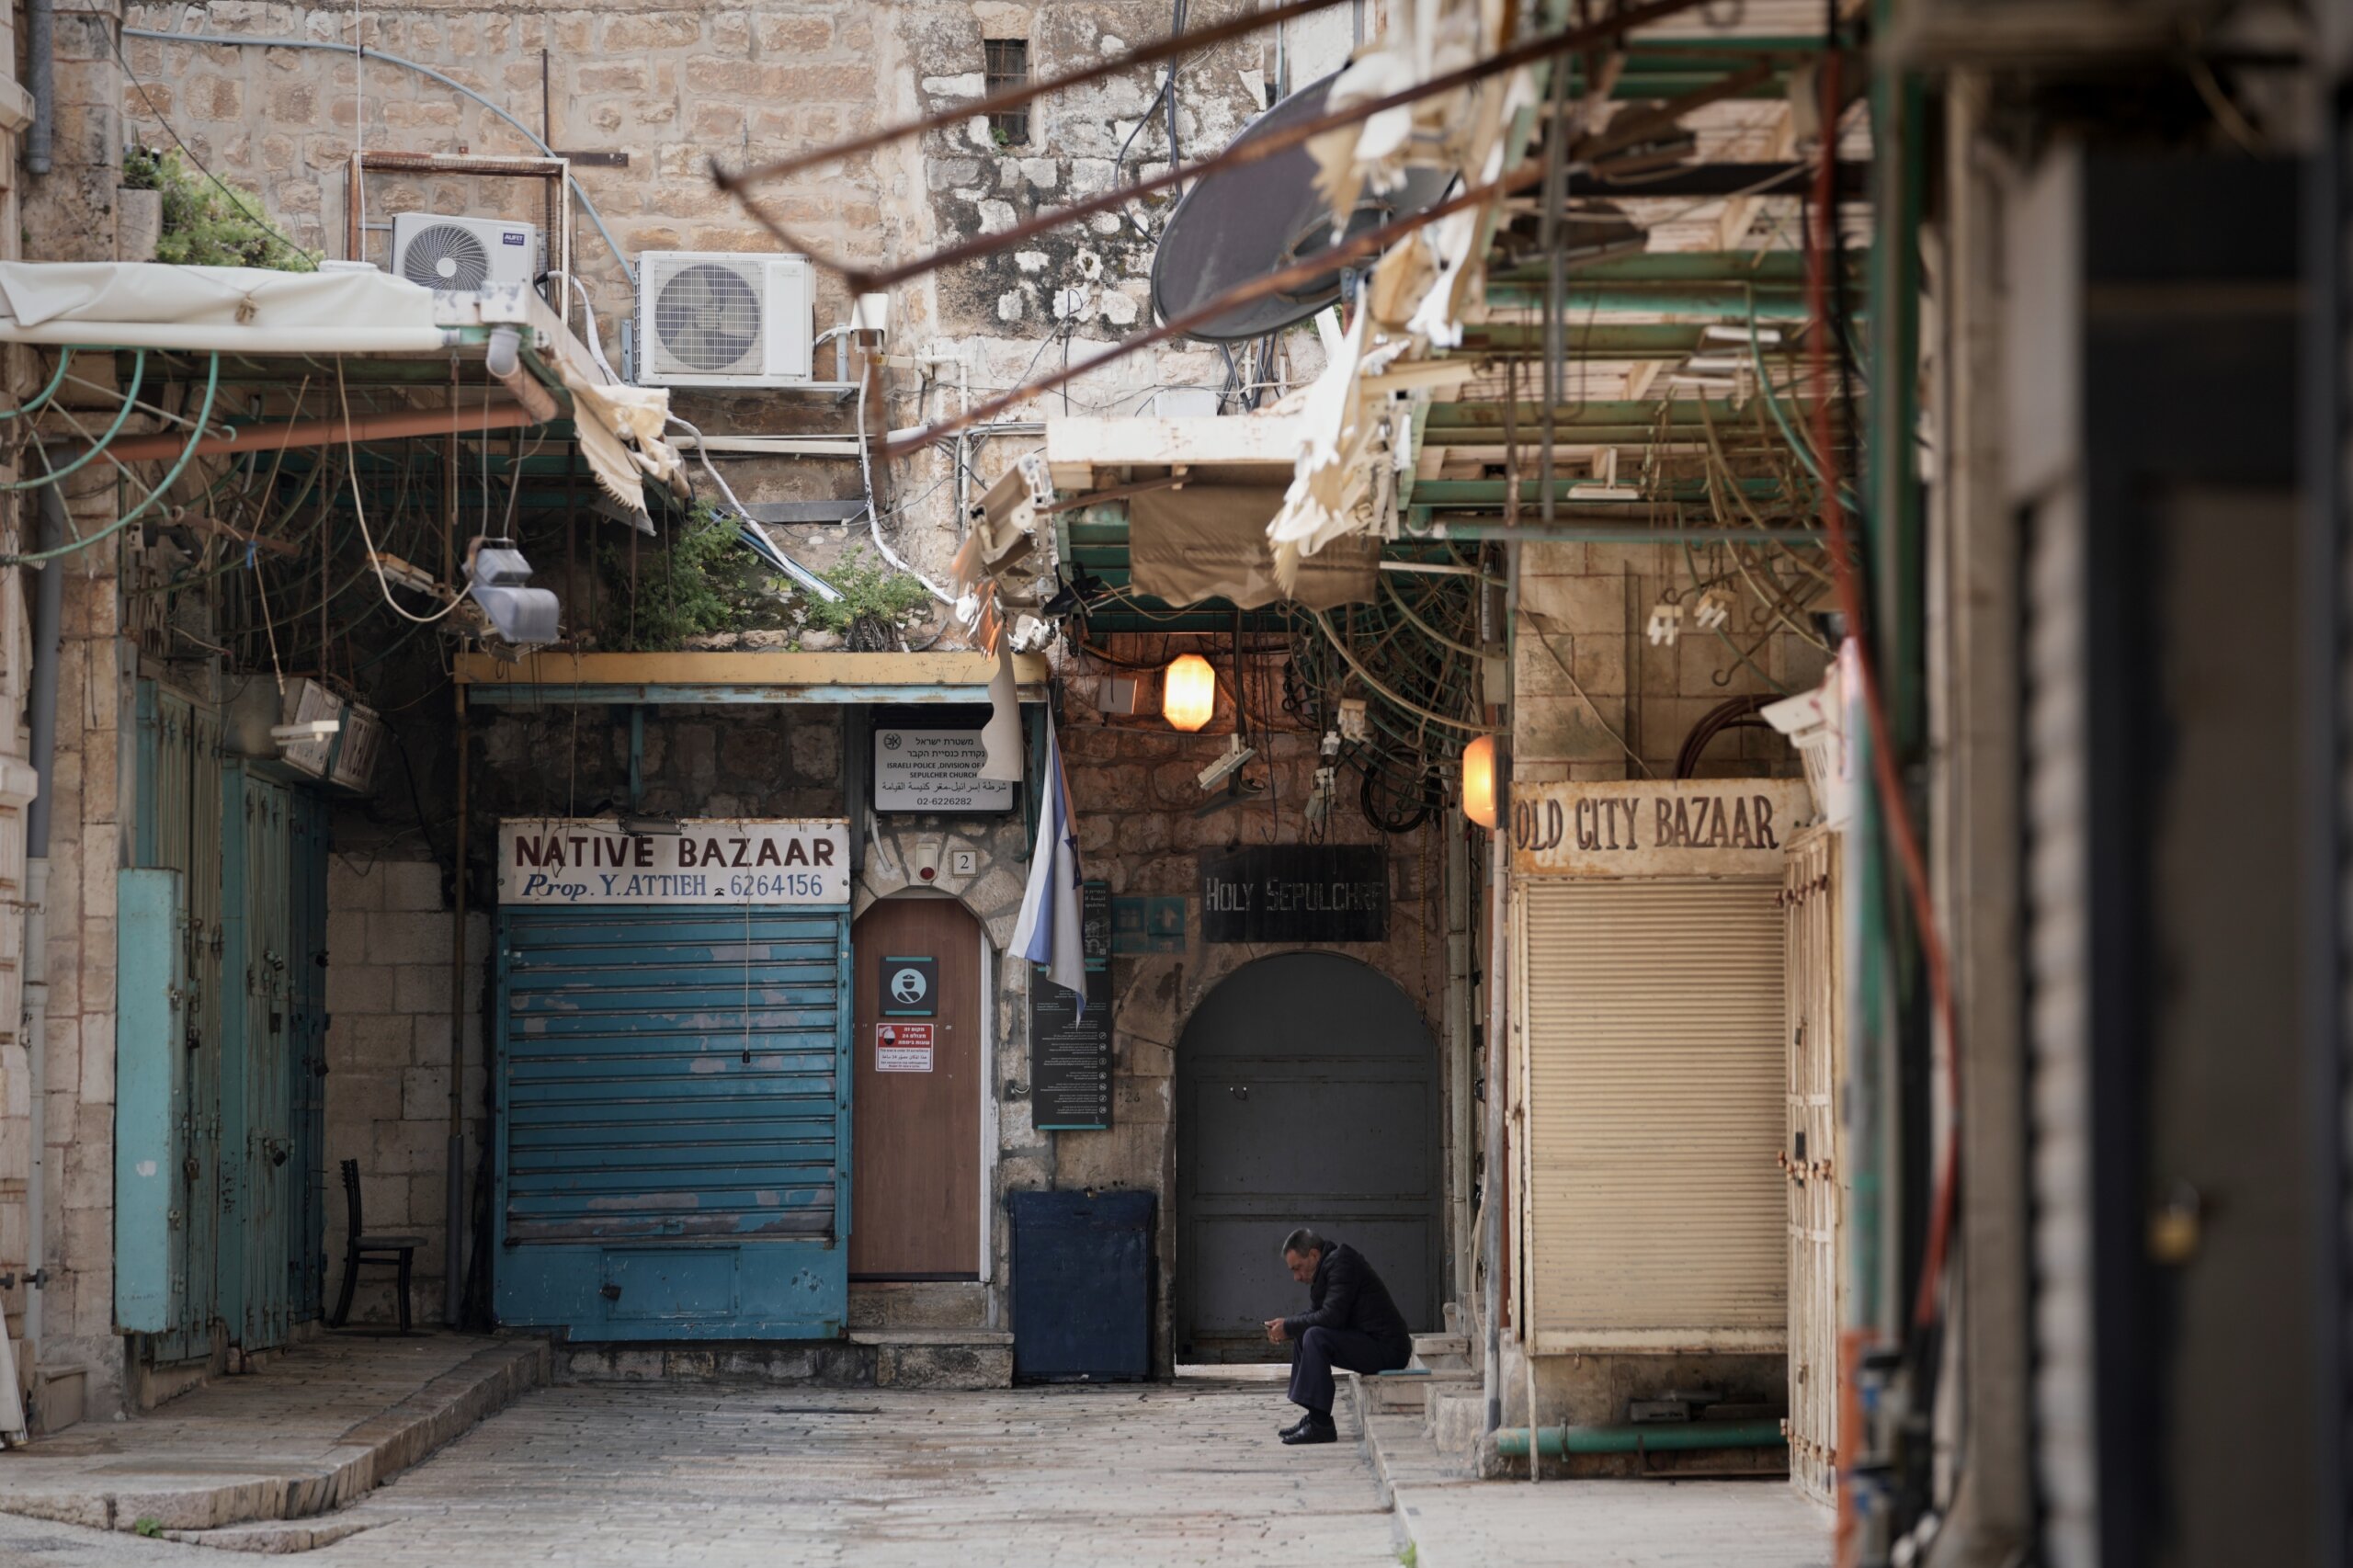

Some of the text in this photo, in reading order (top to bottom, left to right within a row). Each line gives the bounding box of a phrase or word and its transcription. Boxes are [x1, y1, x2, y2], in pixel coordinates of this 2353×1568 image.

[915, 736, 974, 745] משטרת ישראל
[907, 750, 929, 759] הקבר
[961, 750, 985, 759] נקודת
[882, 781, 905, 792] القيامة
[908, 781, 930, 792] كنيسة
[983, 781, 1007, 792] شرطة
[916, 797, 972, 805] 02-6226282
[1517, 794, 1779, 851] OLD CITY BAZAAR
[515, 835, 835, 868] NATIVE BAZAAR
[961, 855, 969, 869] 2
[521, 873, 595, 901] Prop.
[730, 873, 823, 897] 6264156
[1206, 877, 1255, 912] HOLY
